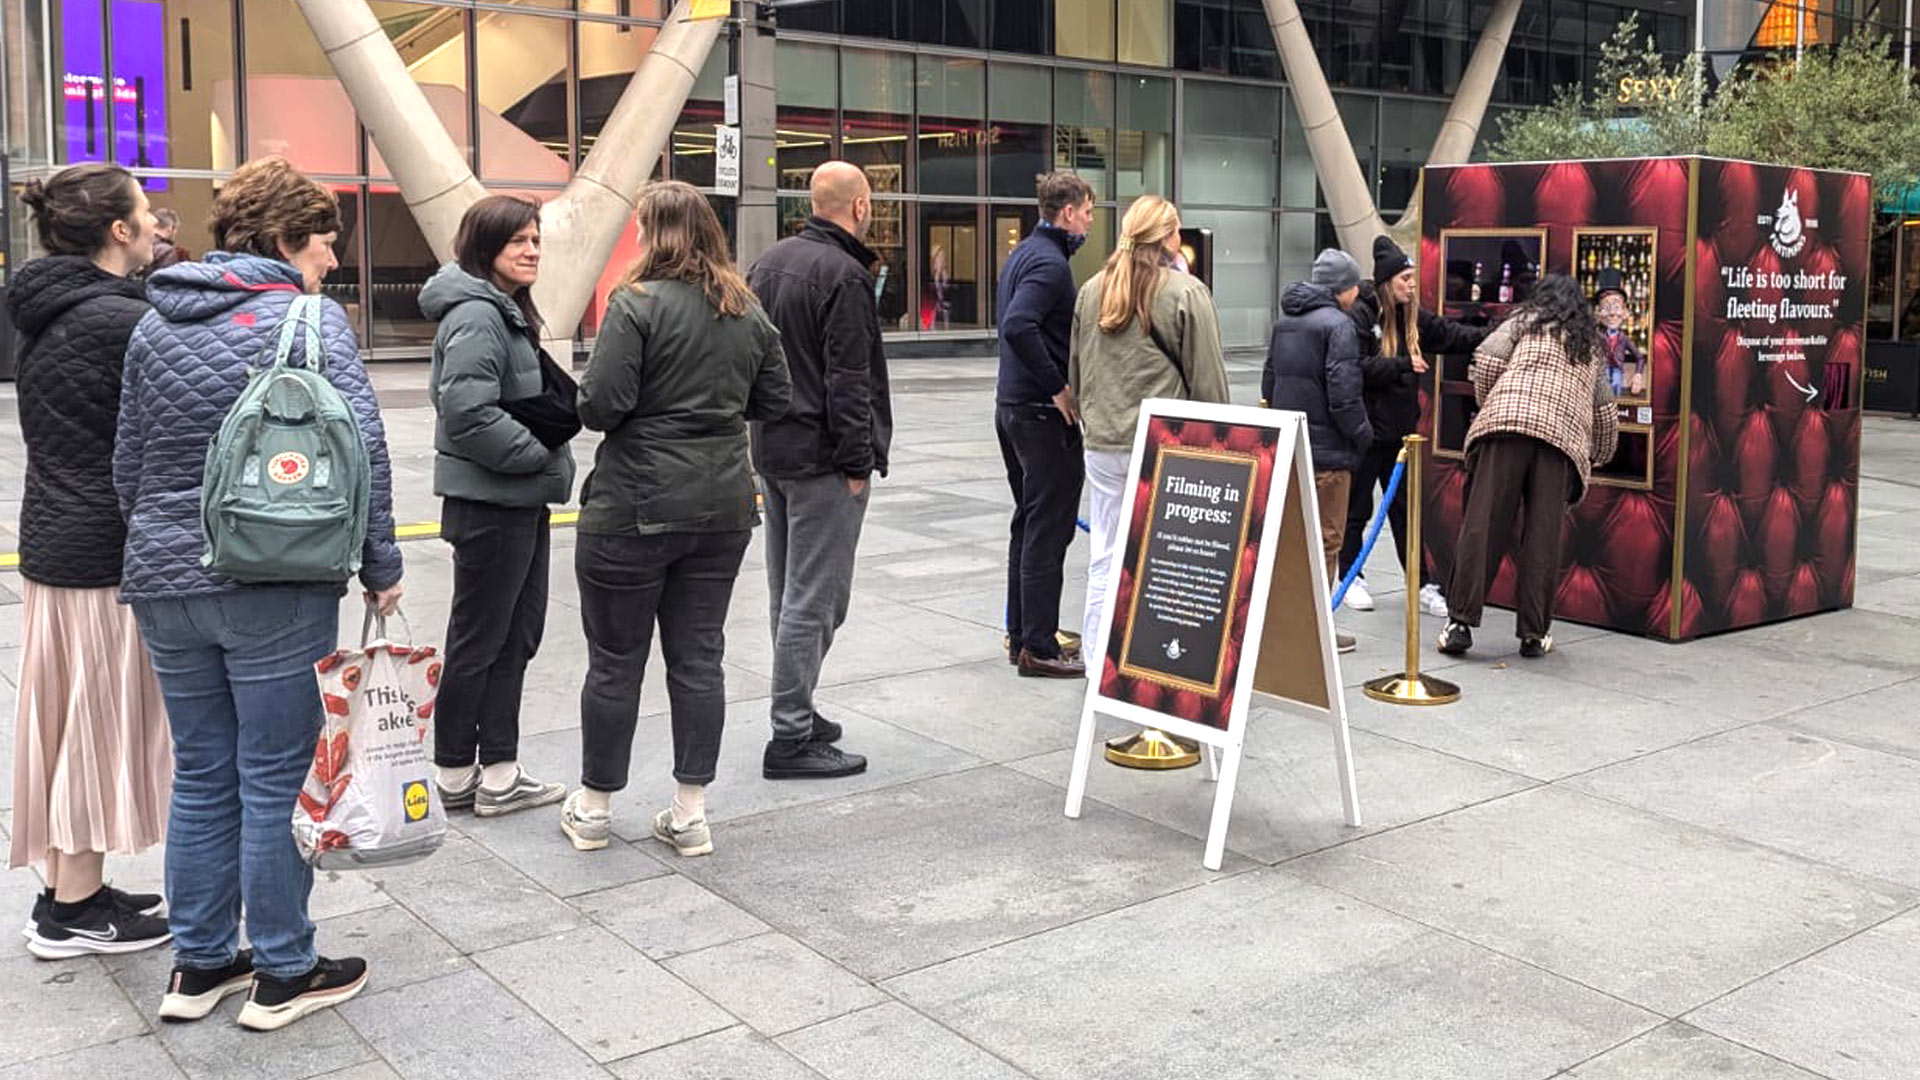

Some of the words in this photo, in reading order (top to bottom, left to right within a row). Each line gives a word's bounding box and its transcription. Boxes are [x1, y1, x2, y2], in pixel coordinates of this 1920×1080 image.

[1618, 77, 1682, 102] SEXY
[1721, 266, 1754, 288] "Life
[1756, 268, 1768, 288] is
[1770, 271, 1791, 289] too
[1793, 268, 1826, 289] short
[1828, 269, 1847, 290] for
[1727, 297, 1777, 324] fleeting
[1780, 298, 1839, 319] flavours."
[1165, 476, 1221, 504] Filming
[1223, 483, 1239, 502] in
[1164, 502, 1232, 524] progress:
